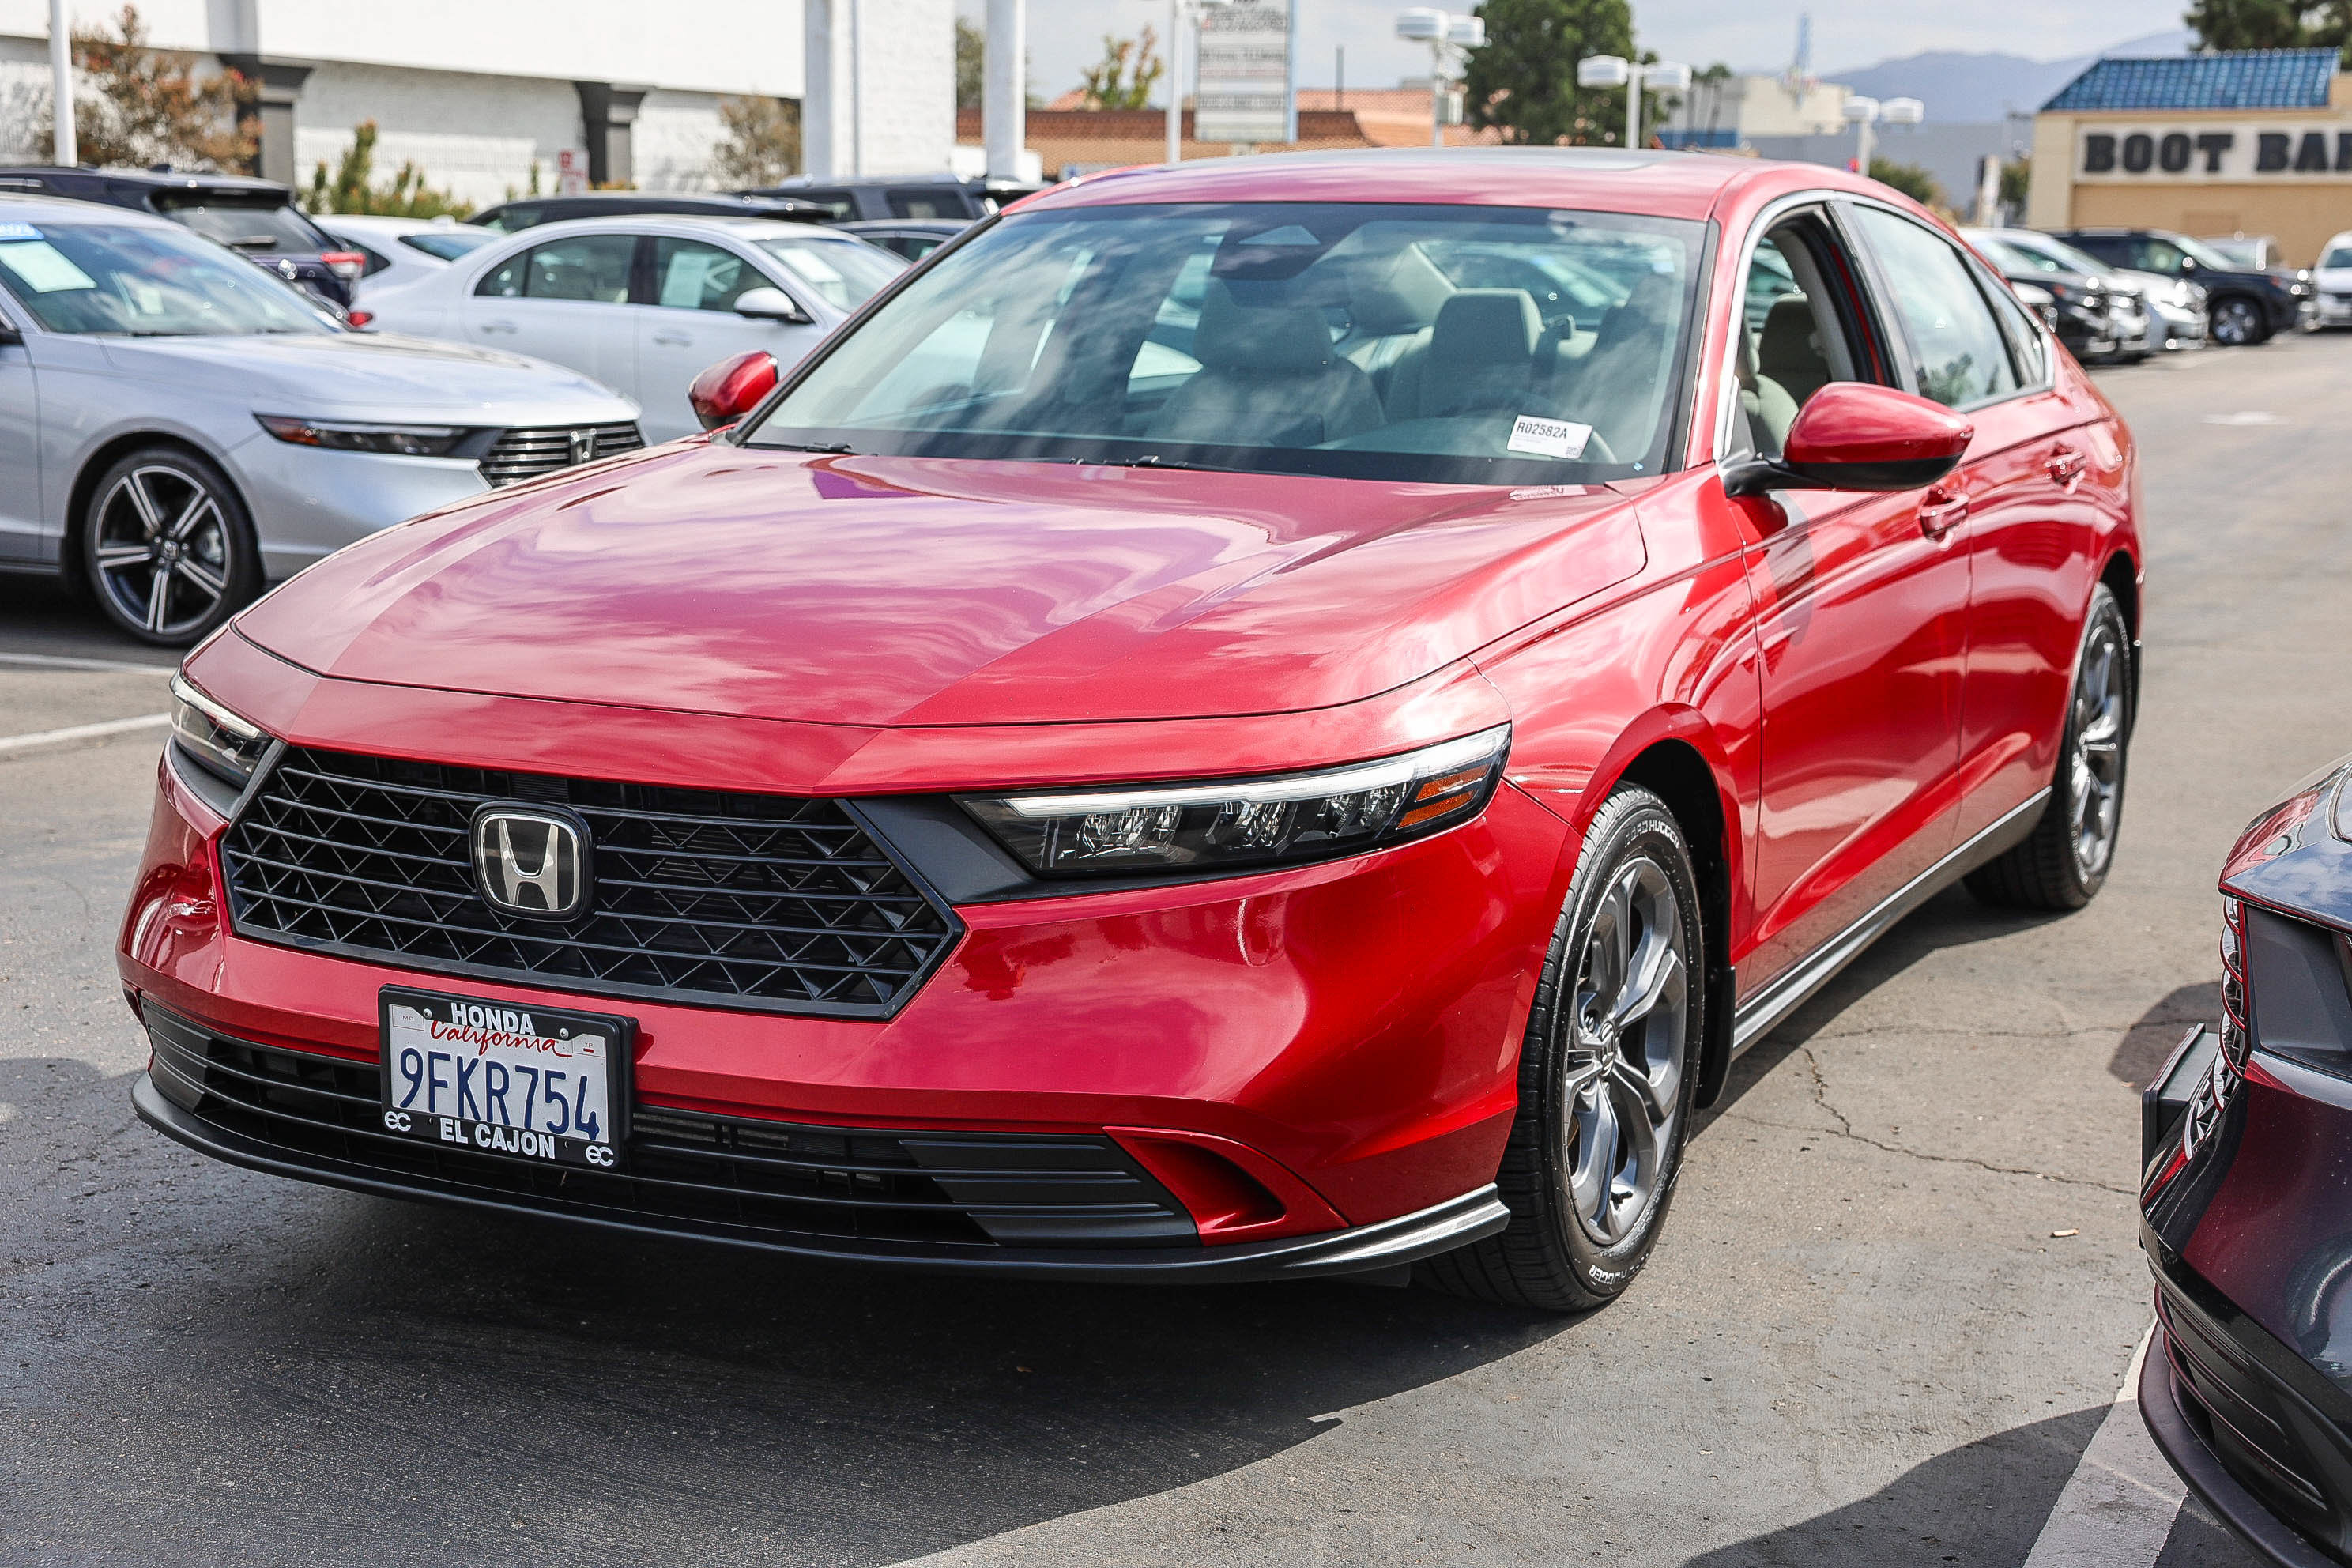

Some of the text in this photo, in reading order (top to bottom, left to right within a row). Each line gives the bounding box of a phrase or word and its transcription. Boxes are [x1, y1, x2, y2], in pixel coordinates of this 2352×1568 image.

[2084, 132, 2233, 174] BOOT
[1517, 421, 1567, 439] R02582A
[430, 1020, 573, 1057] California
[450, 1002, 537, 1036] HONDA
[400, 1047, 601, 1140] 9FKR754
[439, 1117, 556, 1159] EL CAJON
